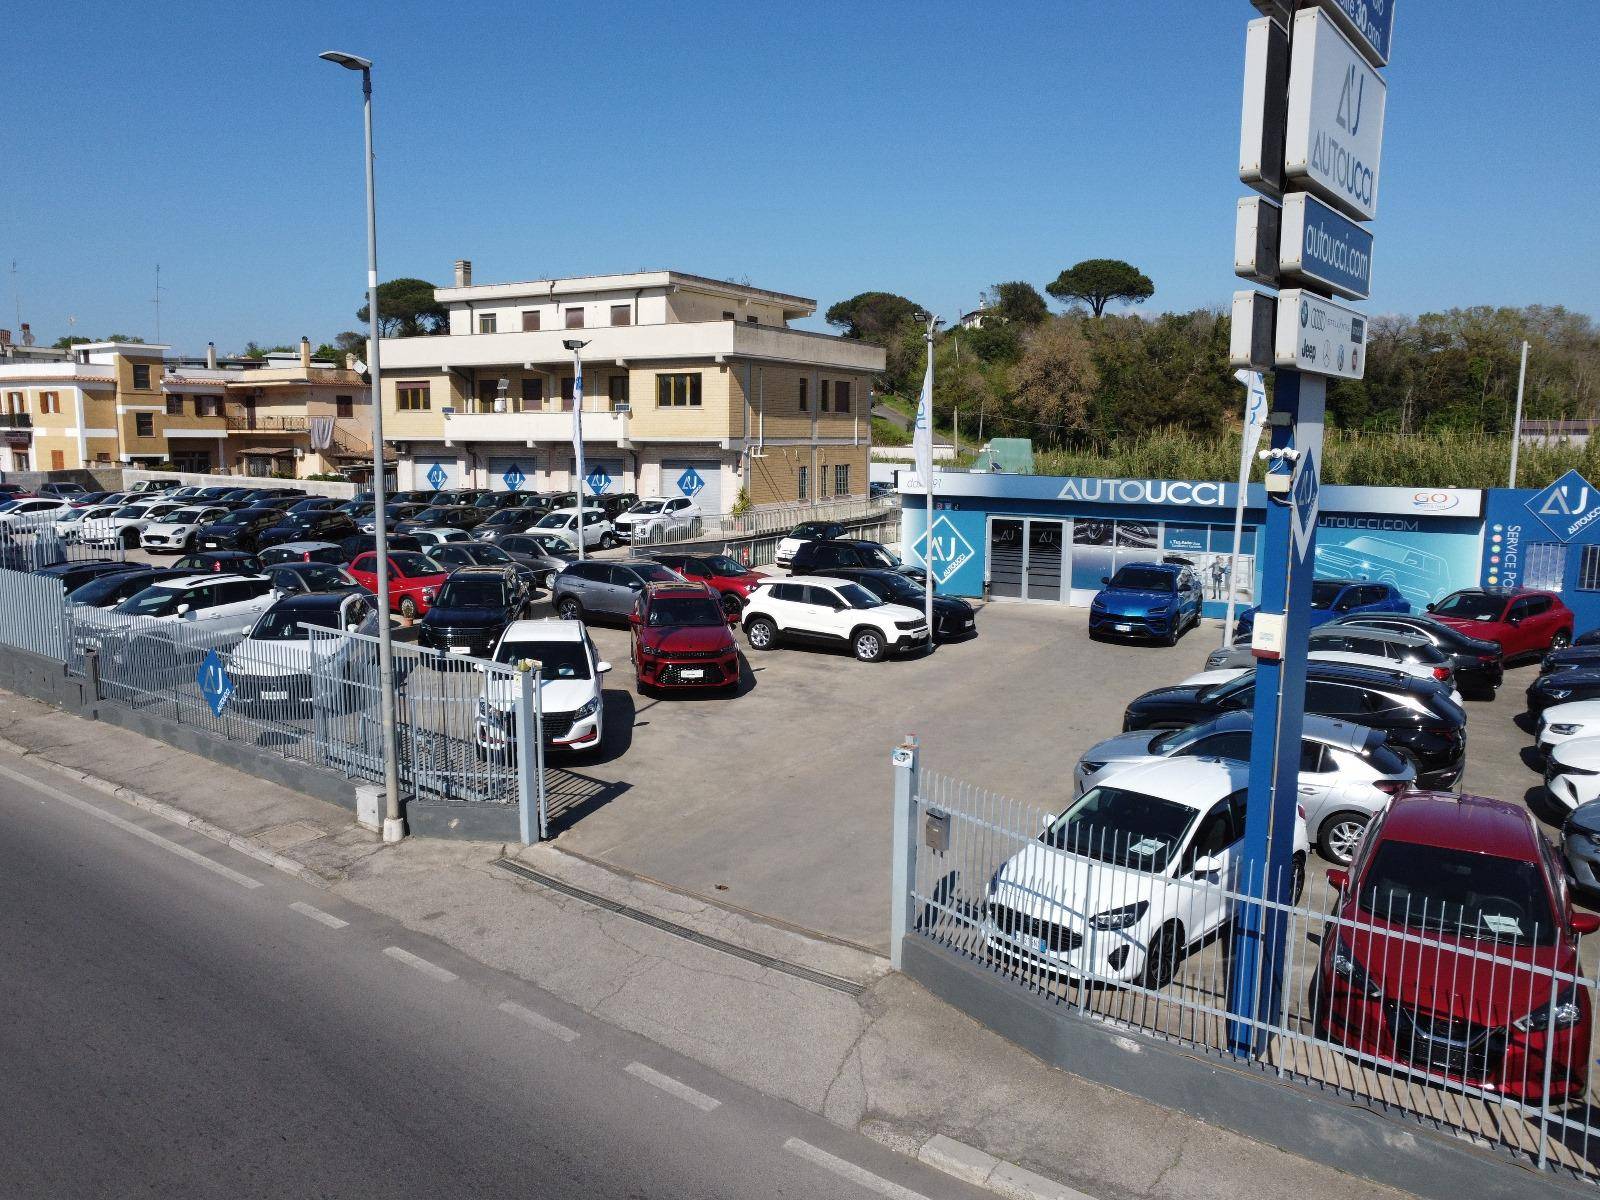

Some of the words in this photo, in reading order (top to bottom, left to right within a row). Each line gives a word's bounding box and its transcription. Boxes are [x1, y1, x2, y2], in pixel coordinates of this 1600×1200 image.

[1311, 130, 1374, 208] AUTOUCCI
[1305, 221, 1368, 282] autoucci.com
[1301, 338, 1316, 363] Jeep
[1056, 478, 1225, 506] AUTOUCCI
[1414, 493, 1448, 503] GO
[1317, 516, 1419, 531] UTOUCCI.COM
[1567, 506, 1600, 535] AUTOUCC
[1503, 525, 1521, 569] SERVICE
